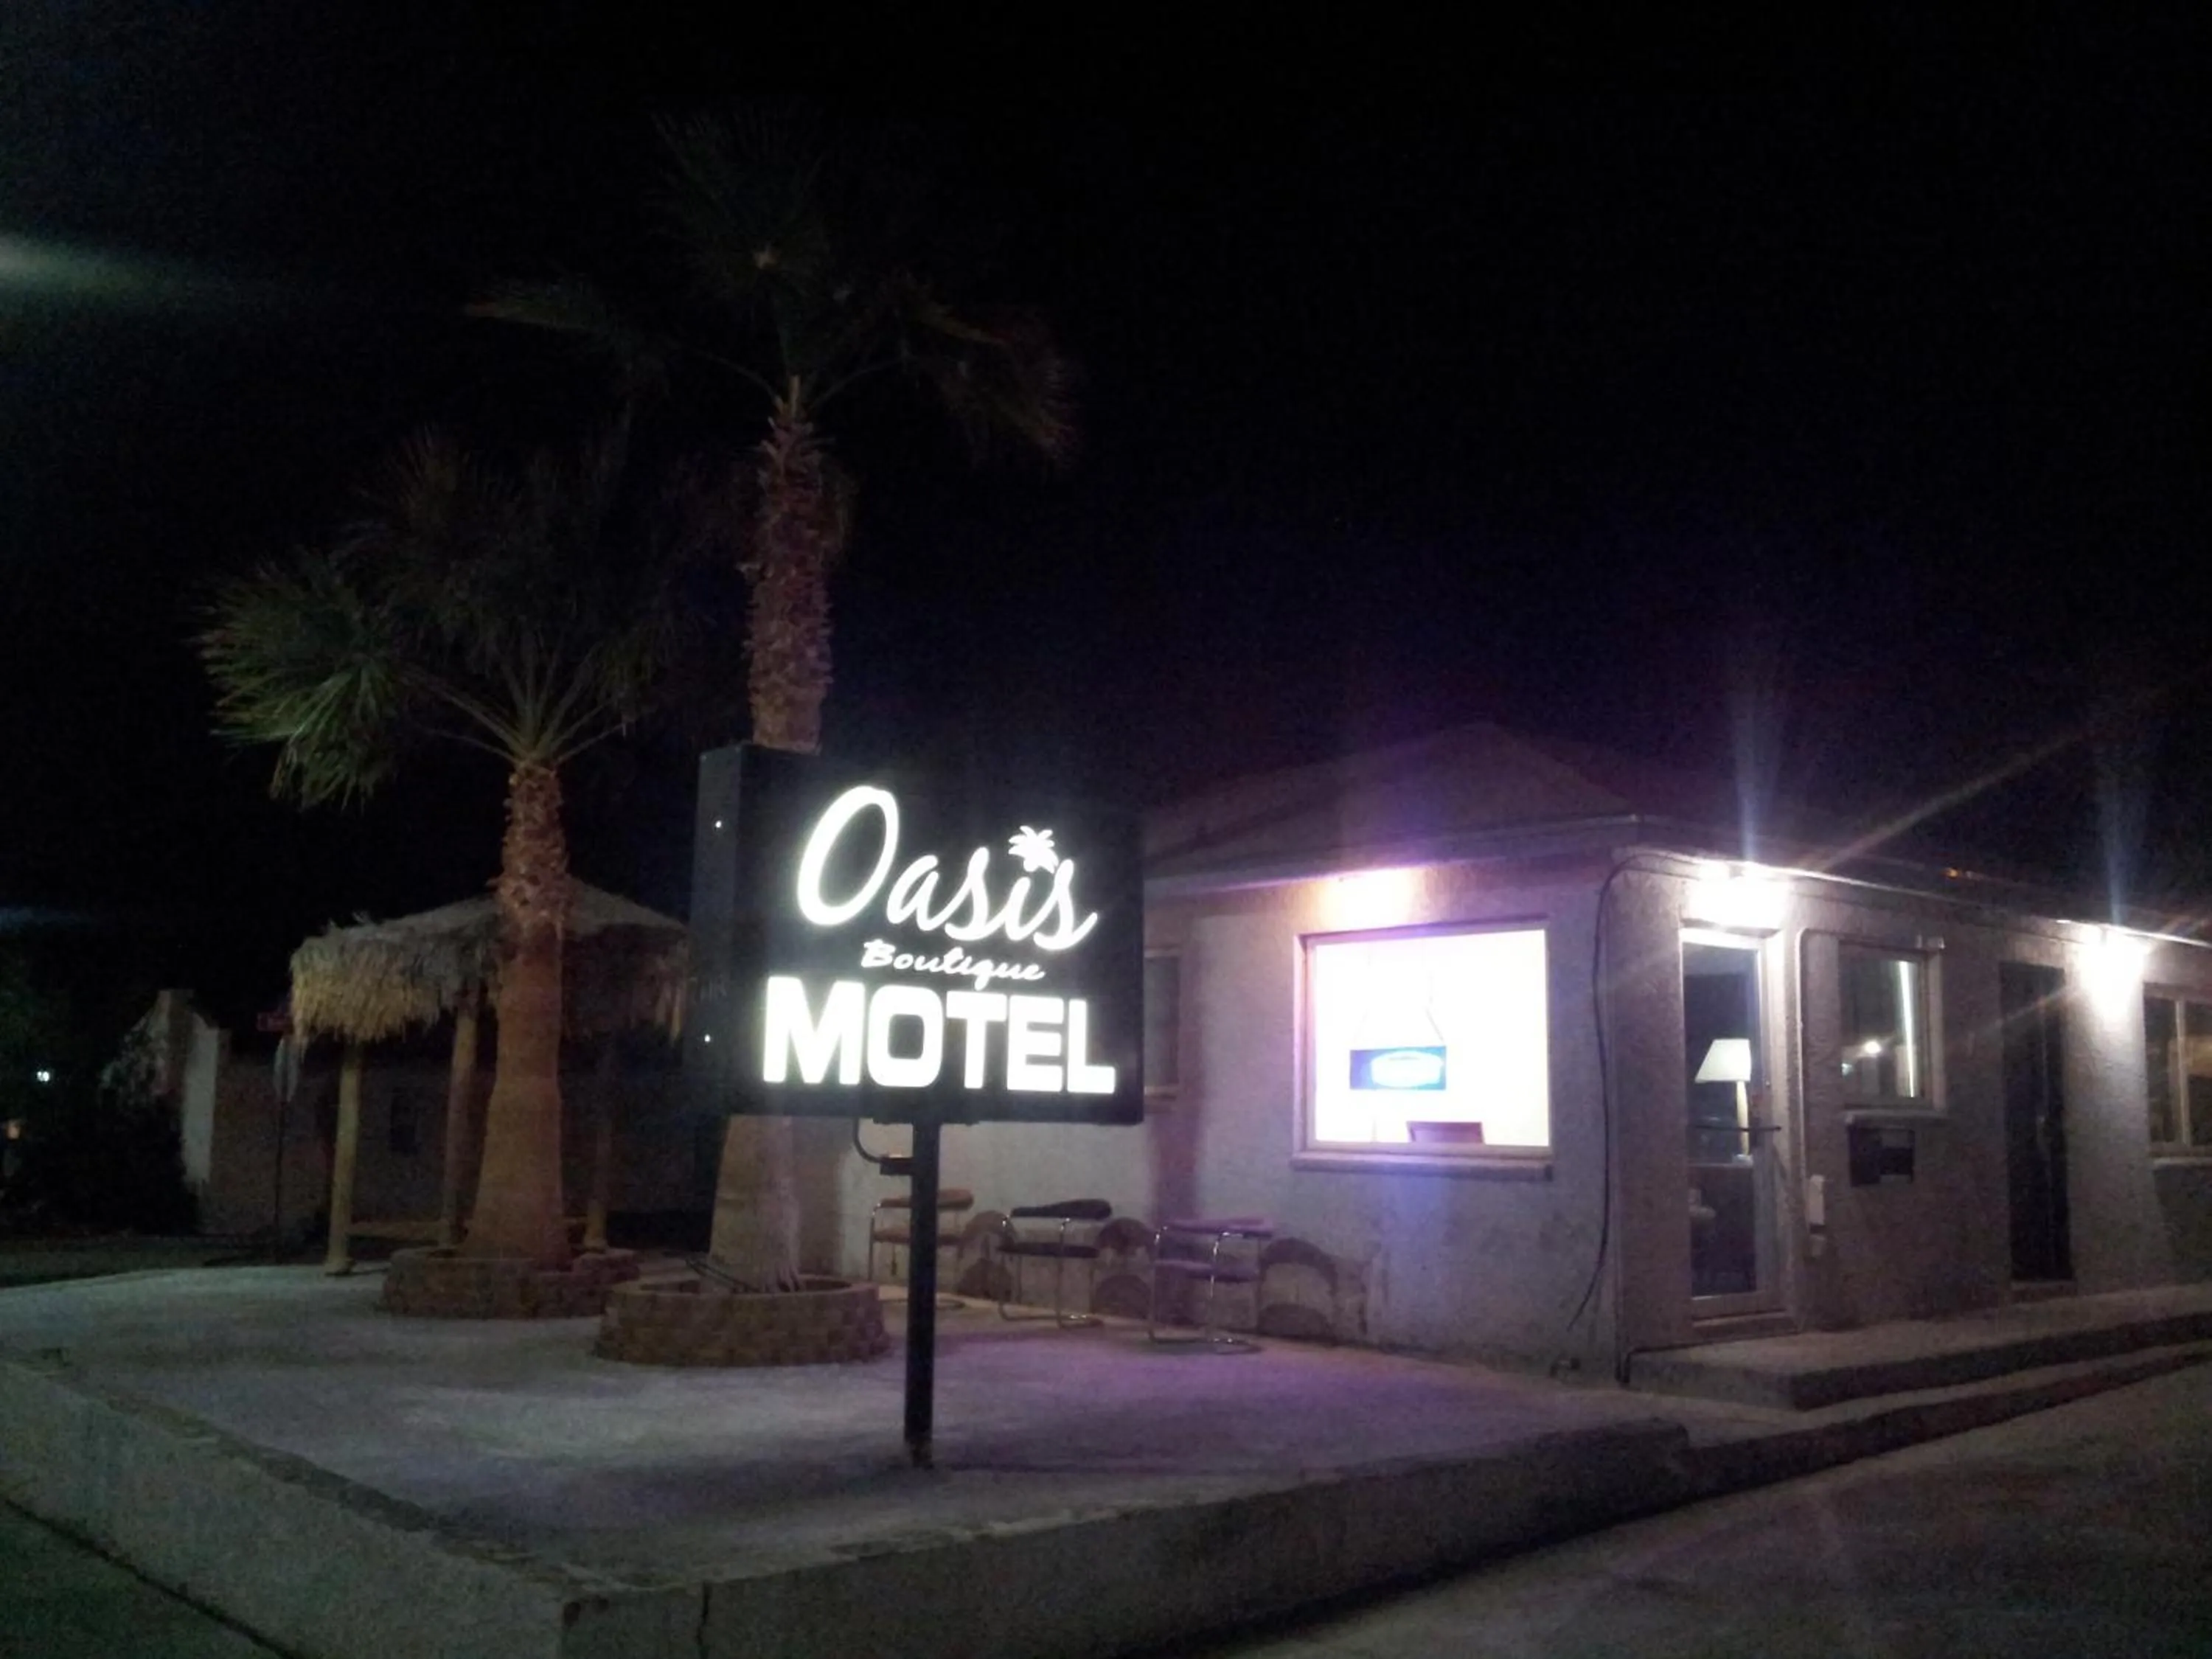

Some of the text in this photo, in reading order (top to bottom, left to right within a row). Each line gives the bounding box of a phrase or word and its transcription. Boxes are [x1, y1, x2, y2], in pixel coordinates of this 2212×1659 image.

[797, 785, 1098, 950] Oasis
[860, 939, 1046, 990] Boutique
[762, 976, 1116, 1094] MOTEL
